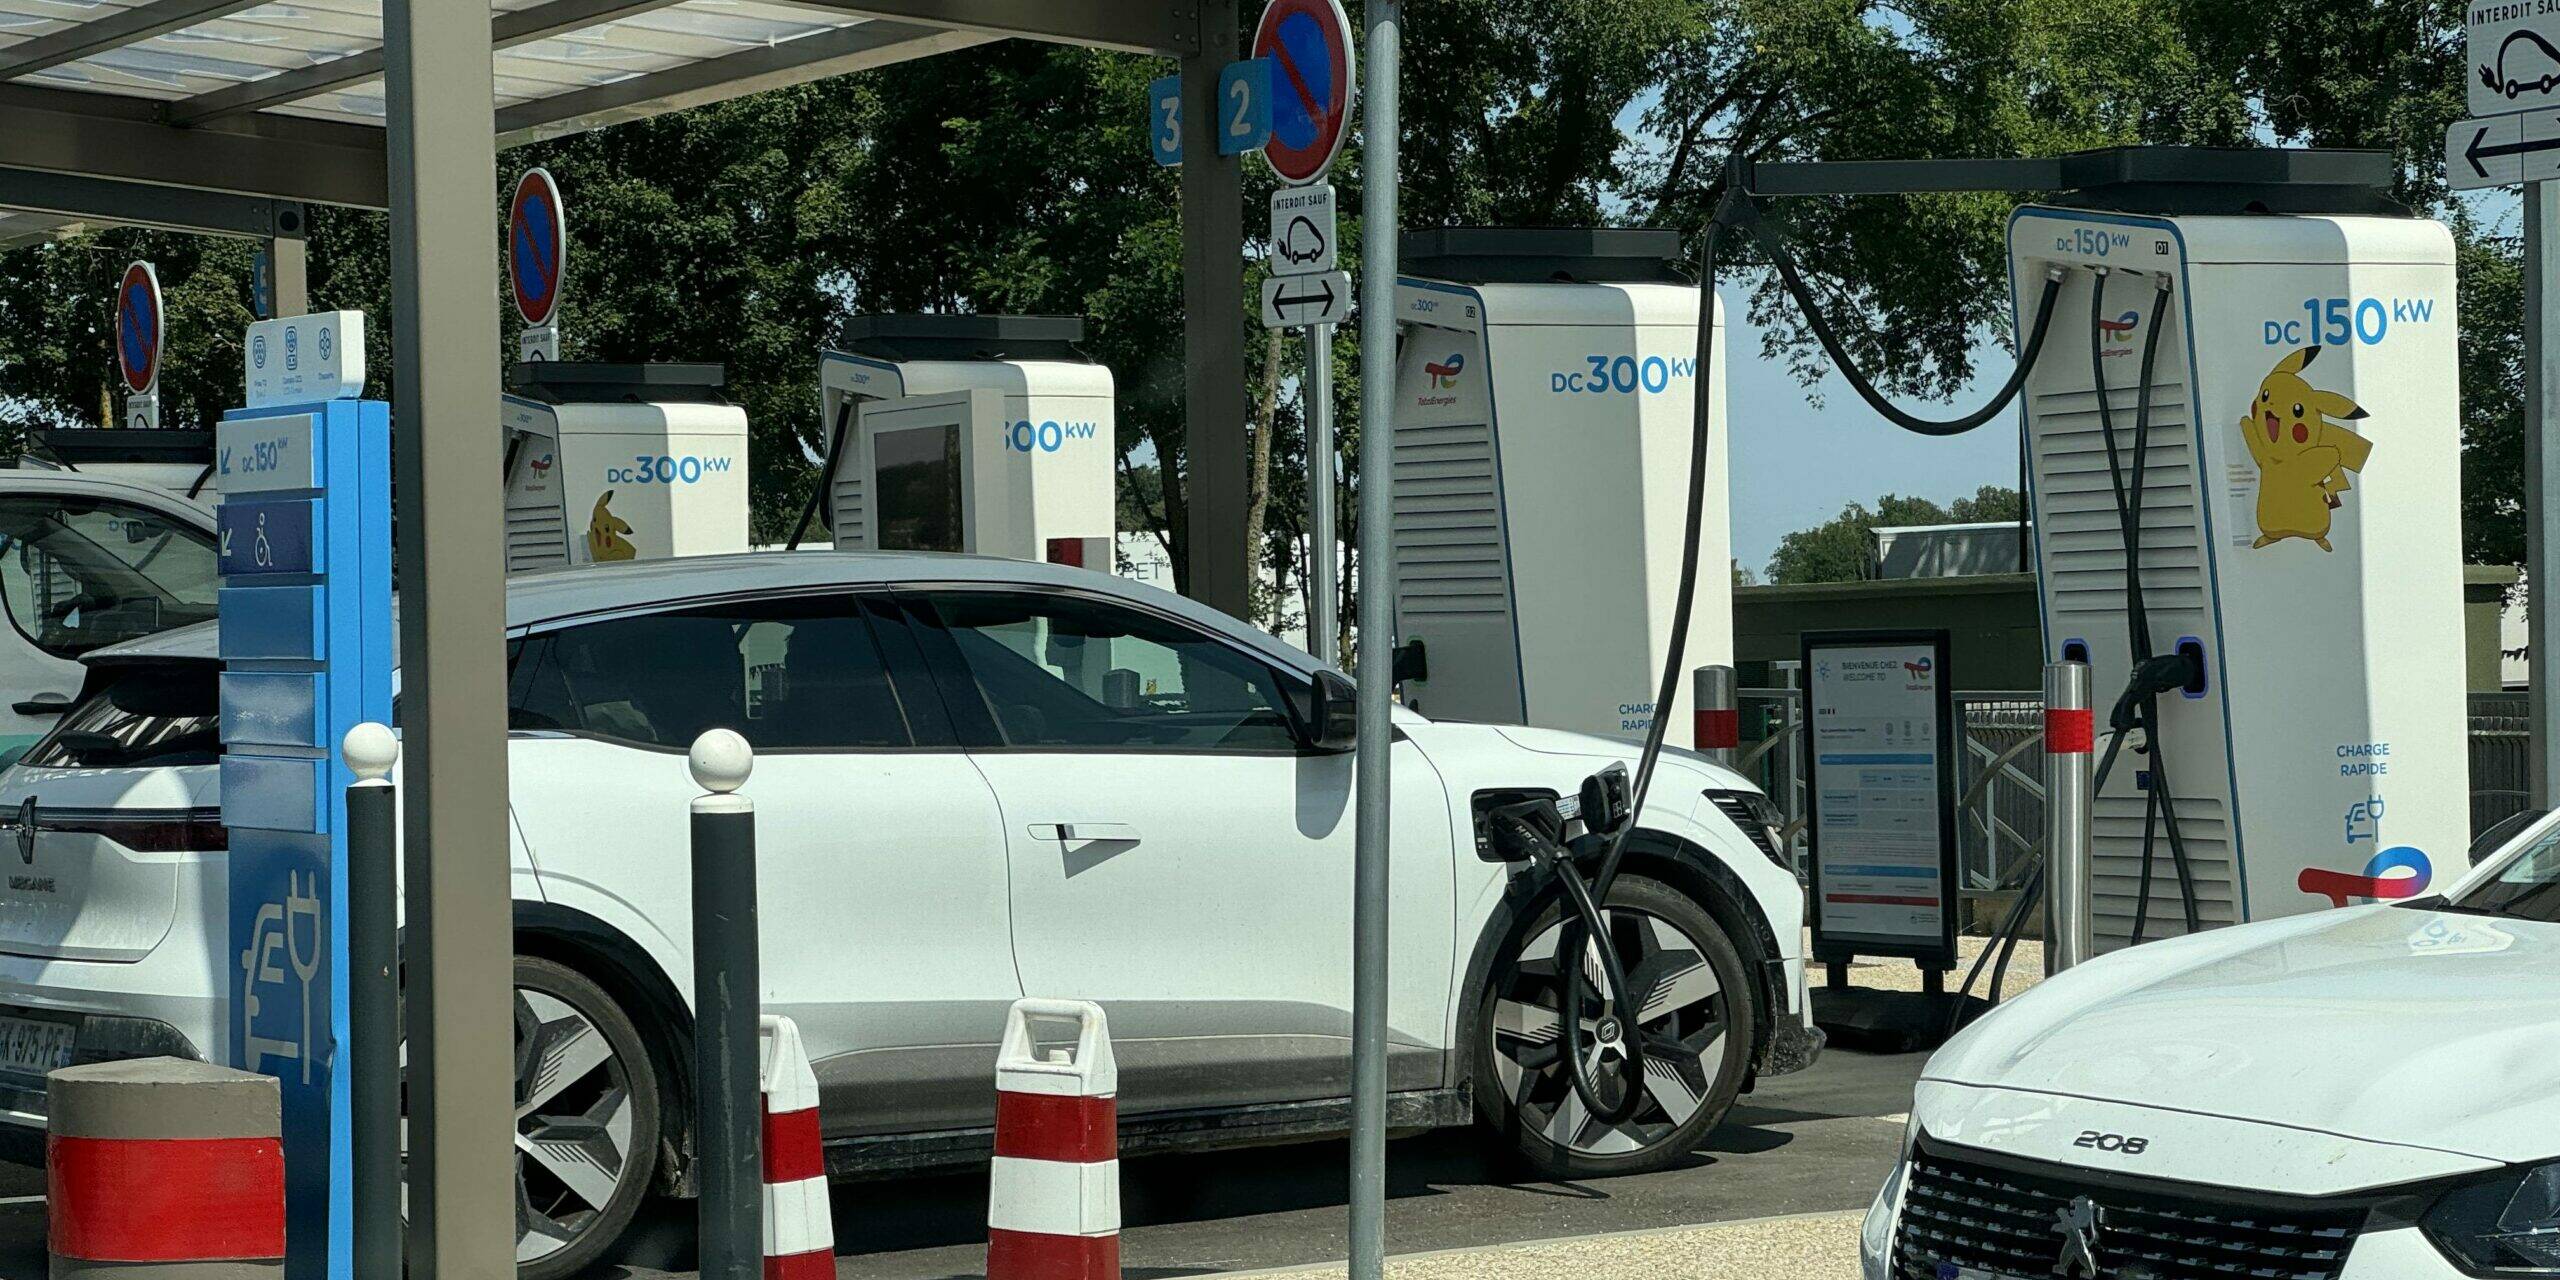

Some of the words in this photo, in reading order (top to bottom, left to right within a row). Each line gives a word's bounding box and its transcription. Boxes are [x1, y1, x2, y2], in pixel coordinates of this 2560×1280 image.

[2472, 2, 2531, 26] INTERDIT
[1229, 79, 1250, 137] 2
[1161, 96, 1180, 152] 3
[1273, 196, 1305, 210] INTERDIT
[1308, 194, 1327, 205] SAUF
[2156, 242, 2168, 254] 01
[1005, 420, 1062, 453] 00
[1622, 719, 1653, 731] RAPI
[2336, 743, 2389, 757] CHARGE
[2341, 763, 2387, 776] RAPIDE
[2073, 1130, 2149, 1154] 208
